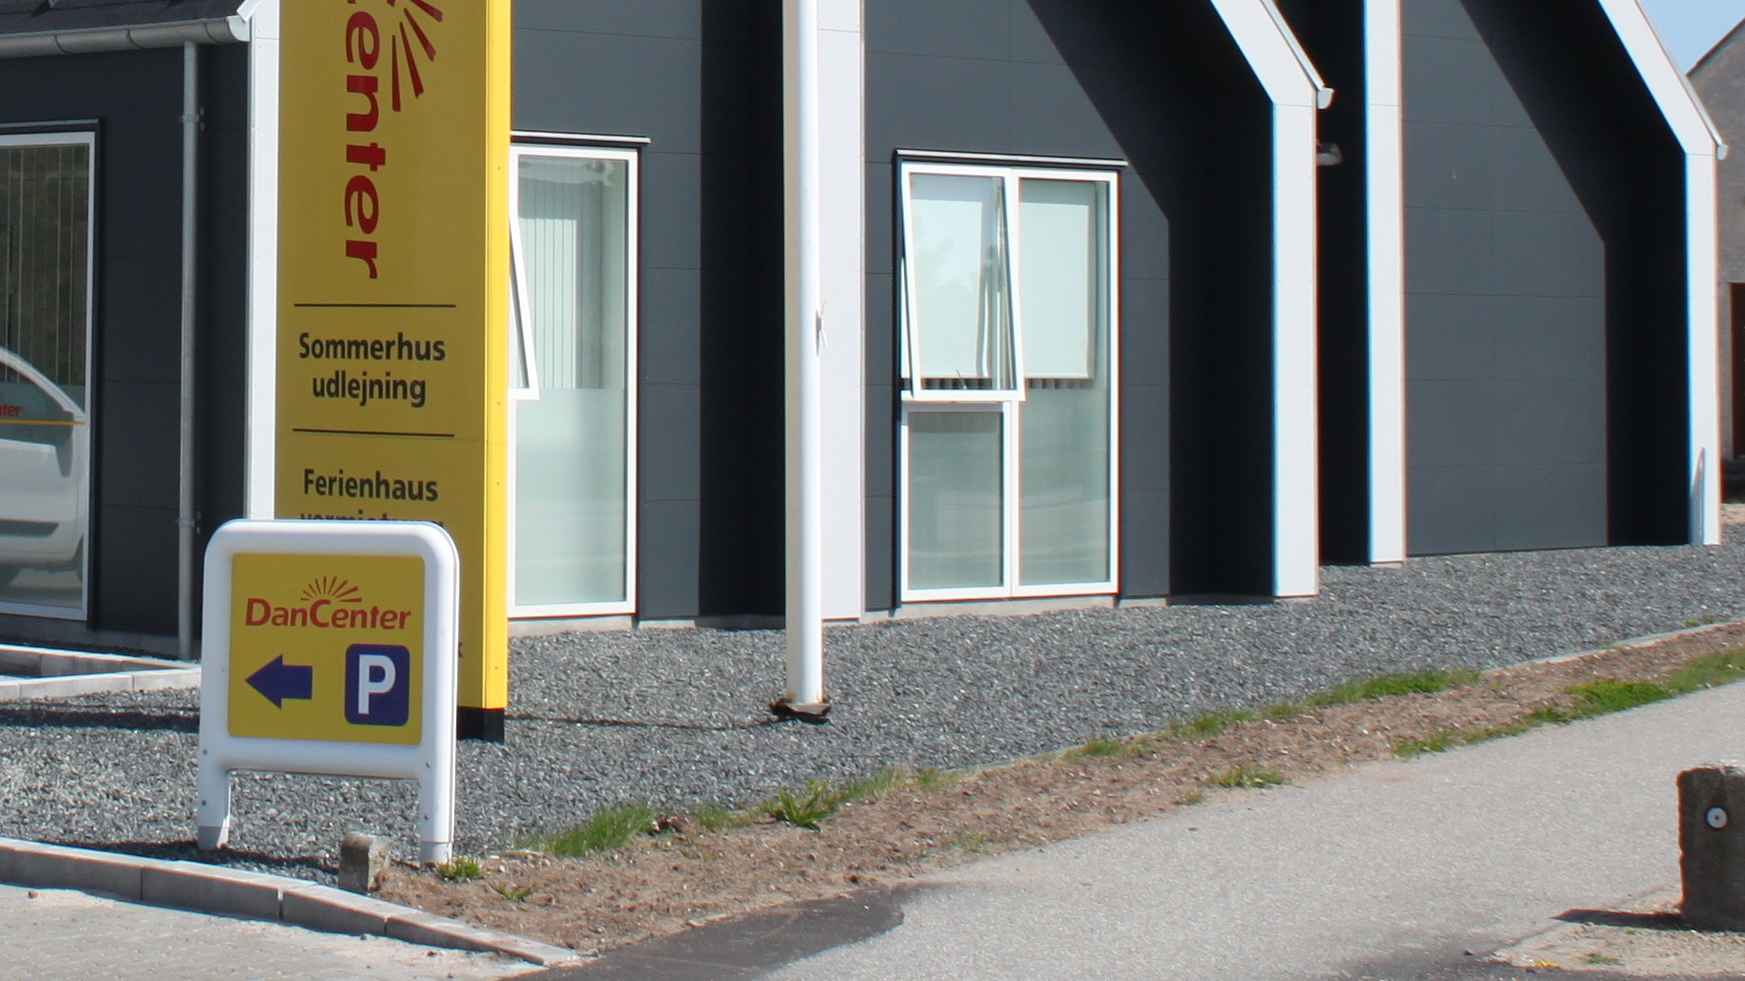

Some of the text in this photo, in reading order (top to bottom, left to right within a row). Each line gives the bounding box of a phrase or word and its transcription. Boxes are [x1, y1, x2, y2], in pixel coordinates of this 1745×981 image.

[299, 332, 446, 361] Sommerhus
[312, 370, 426, 408] udlejning
[304, 468, 438, 501] Ferienhaus
[244, 597, 411, 630] DanCenter
[357, 654, 396, 714] P
